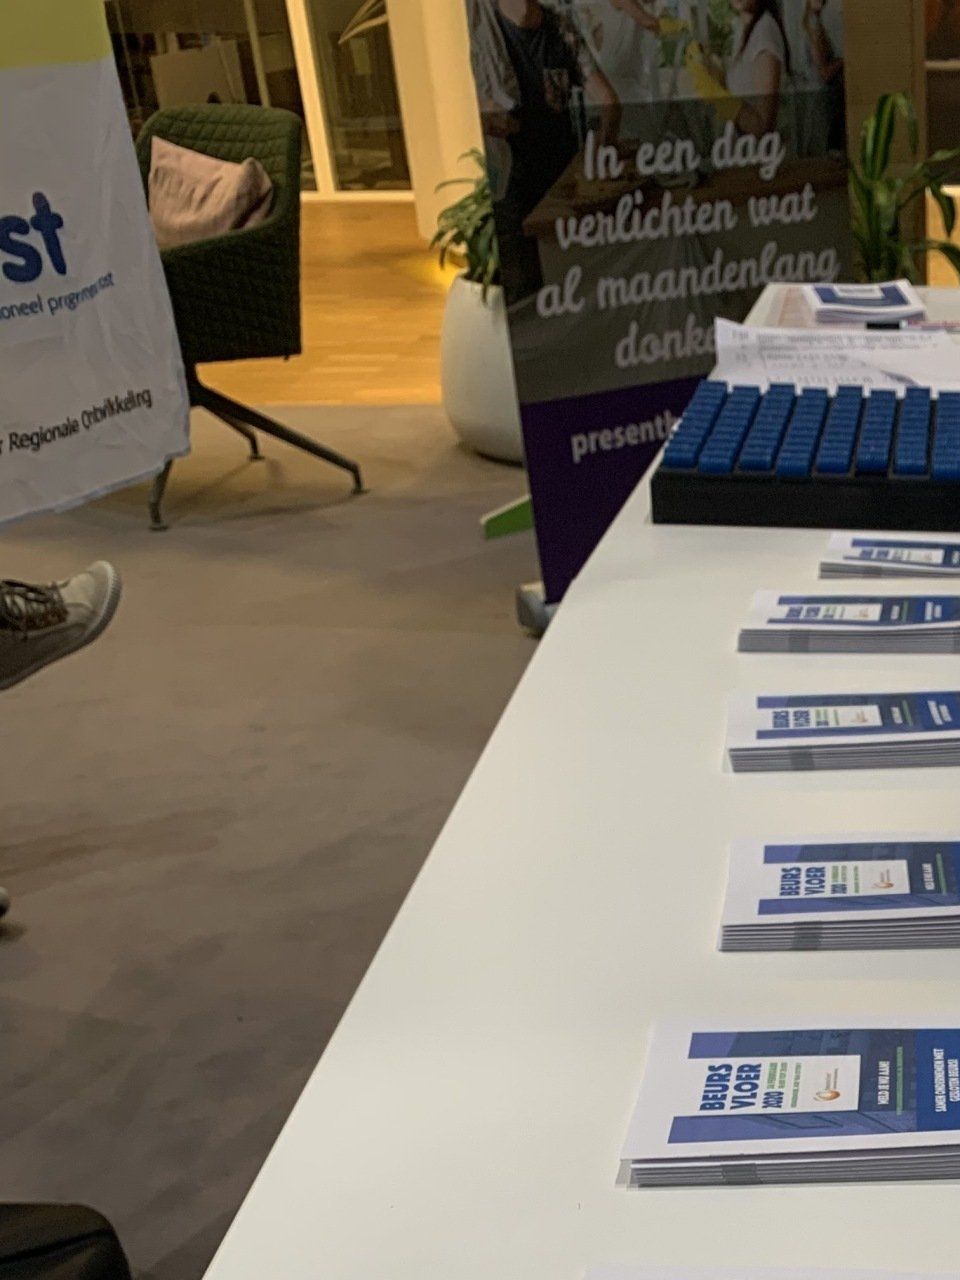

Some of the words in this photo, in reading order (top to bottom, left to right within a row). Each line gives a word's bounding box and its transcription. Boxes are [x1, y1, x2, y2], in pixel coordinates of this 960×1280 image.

[582, 128, 624, 181] In
[635, 139, 700, 176] een
[711, 119, 786, 181] dag
[555, 189, 738, 250] verlichten
[747, 182, 818, 227] wat
[535, 265, 586, 318] al
[596, 240, 842, 309] maandenlang
[8, 416, 80, 453] Regionale
[699, 1063, 733, 1111] BEURS
[729, 1063, 762, 1111] VLOER
[761, 1091, 785, 1109] 2020
